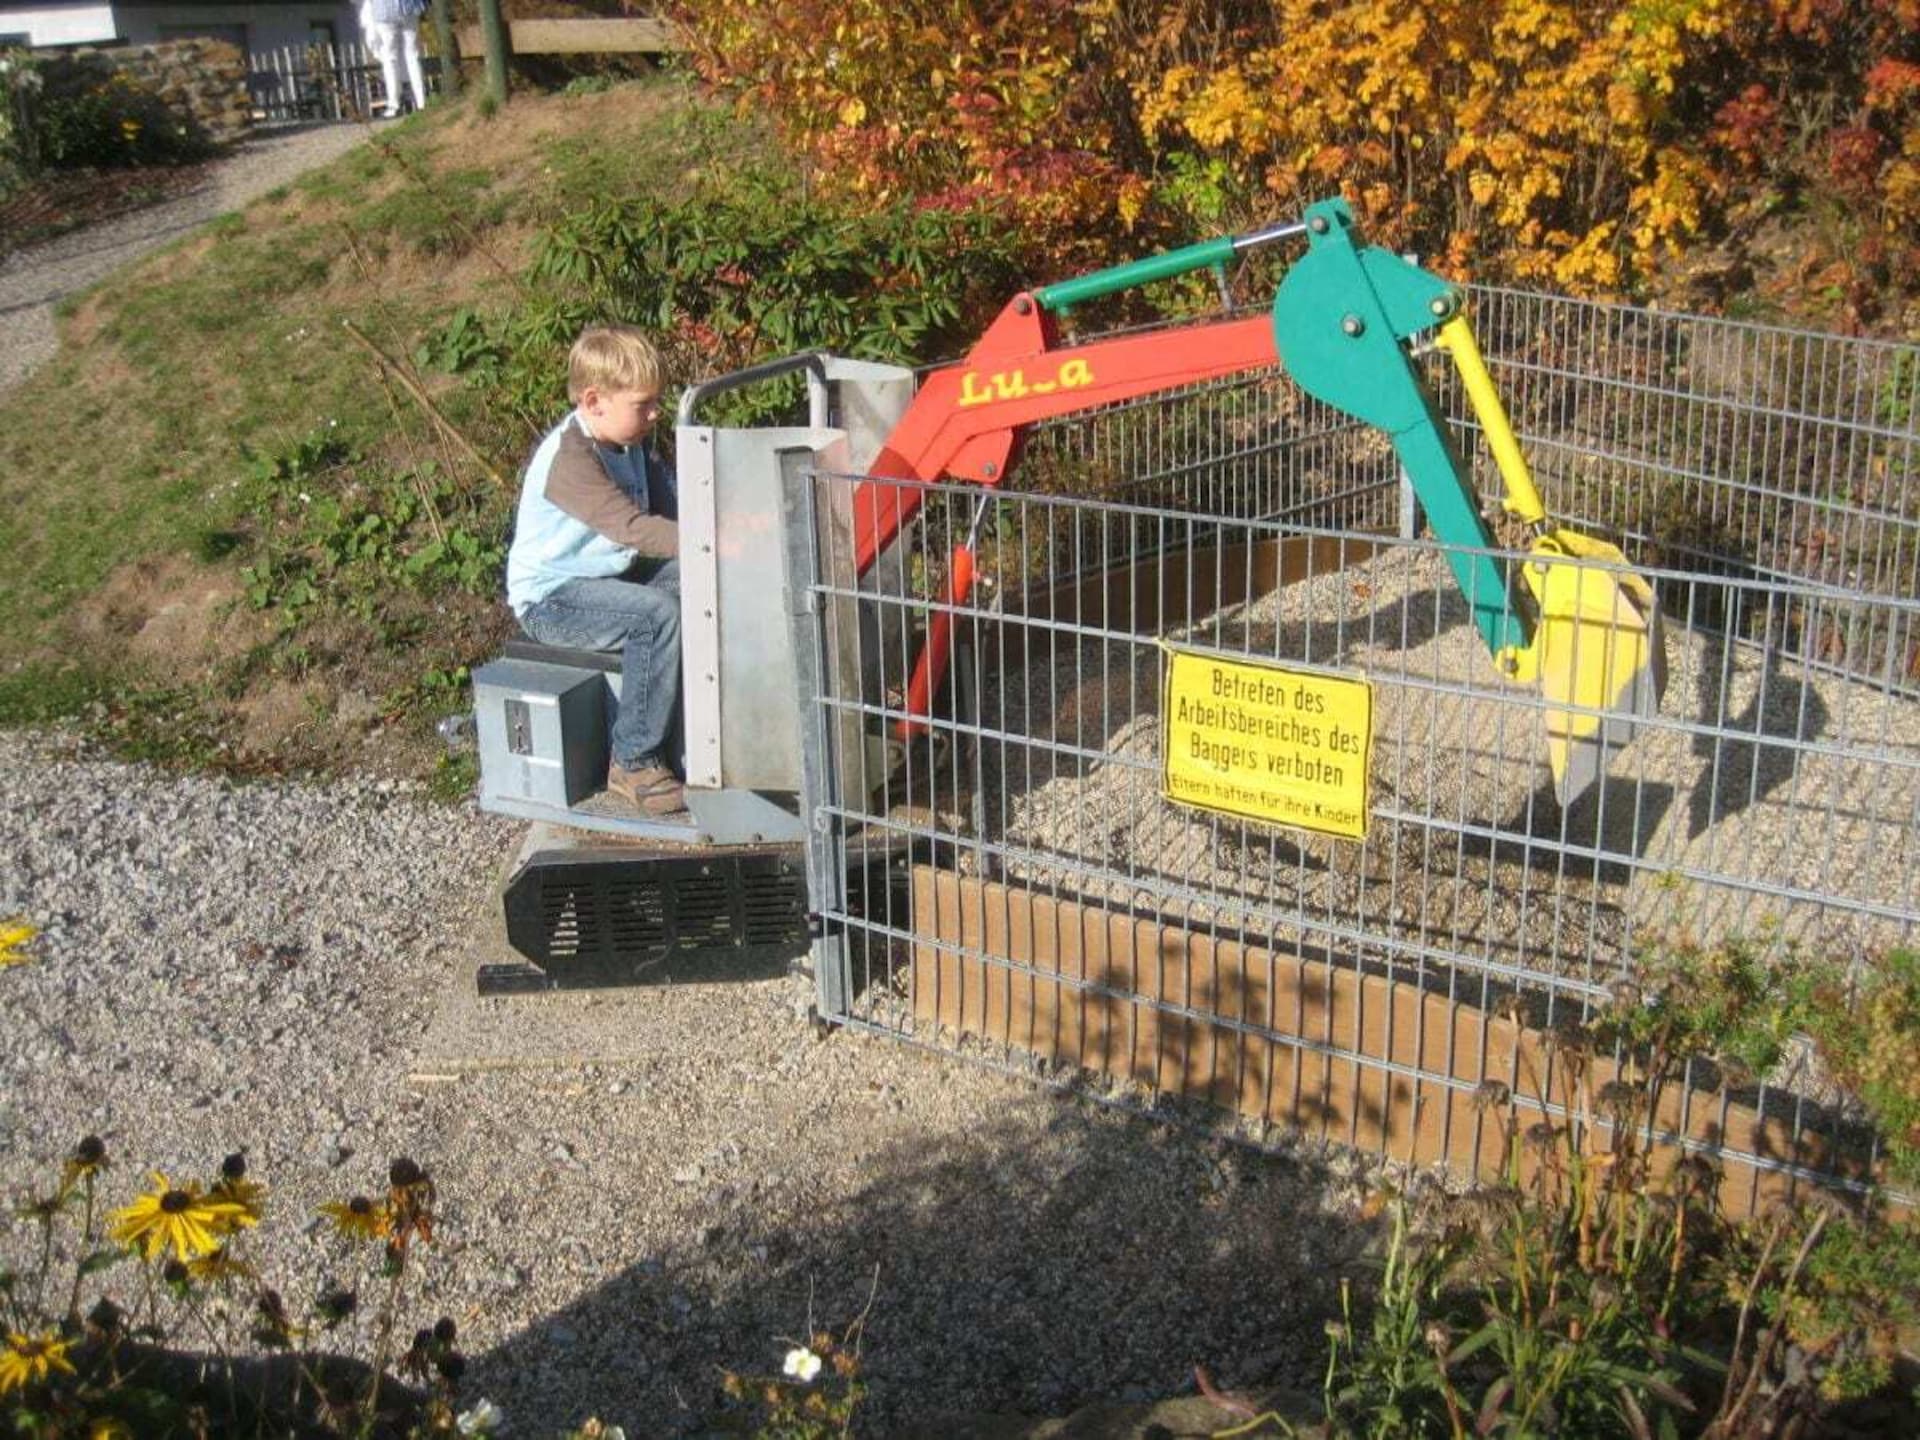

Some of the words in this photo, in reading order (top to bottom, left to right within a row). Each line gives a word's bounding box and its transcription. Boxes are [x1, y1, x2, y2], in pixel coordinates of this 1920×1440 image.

[1212, 669, 1285, 706] Betreten
[1295, 684, 1325, 713] des
[1177, 696, 1322, 748] Arbeitsbereiches
[1328, 724, 1360, 754] des
[1190, 732, 1258, 773] Baggers
[1267, 748, 1344, 787] verboten
[1172, 774, 1210, 796] Eltern
[1215, 783, 1257, 803] haften
[1315, 803, 1358, 825] Kinder
